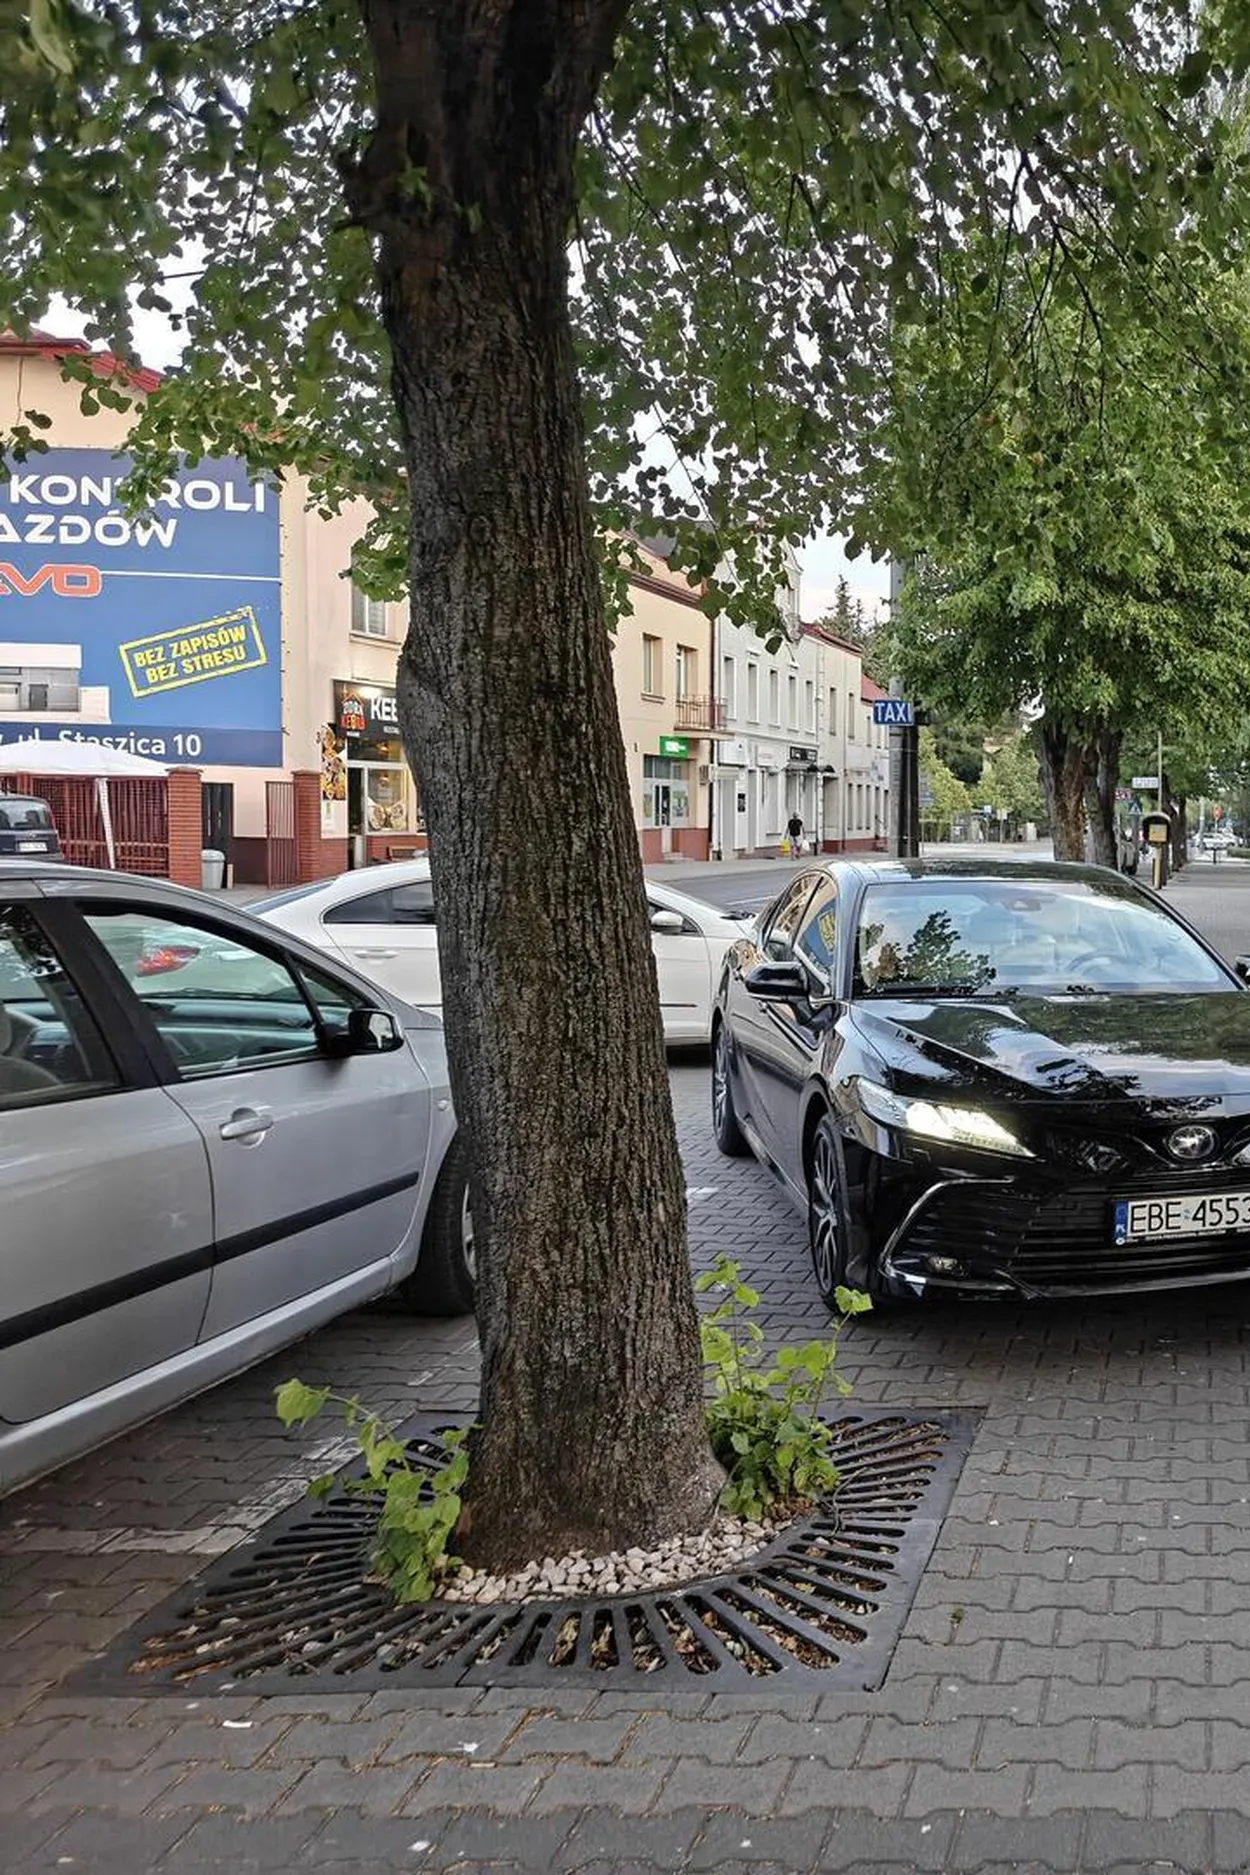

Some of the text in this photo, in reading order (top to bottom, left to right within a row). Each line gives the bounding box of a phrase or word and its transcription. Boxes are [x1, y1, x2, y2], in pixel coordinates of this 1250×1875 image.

[10, 474, 265, 513] KONROLI
[134, 625, 246, 667] BEZ ZAPISÓW
[146, 645, 246, 684] BEZ STRESU
[875, 702, 913, 723] TAXI
[173, 734, 202, 757] 10
[1131, 1201, 1181, 1233] EBE
